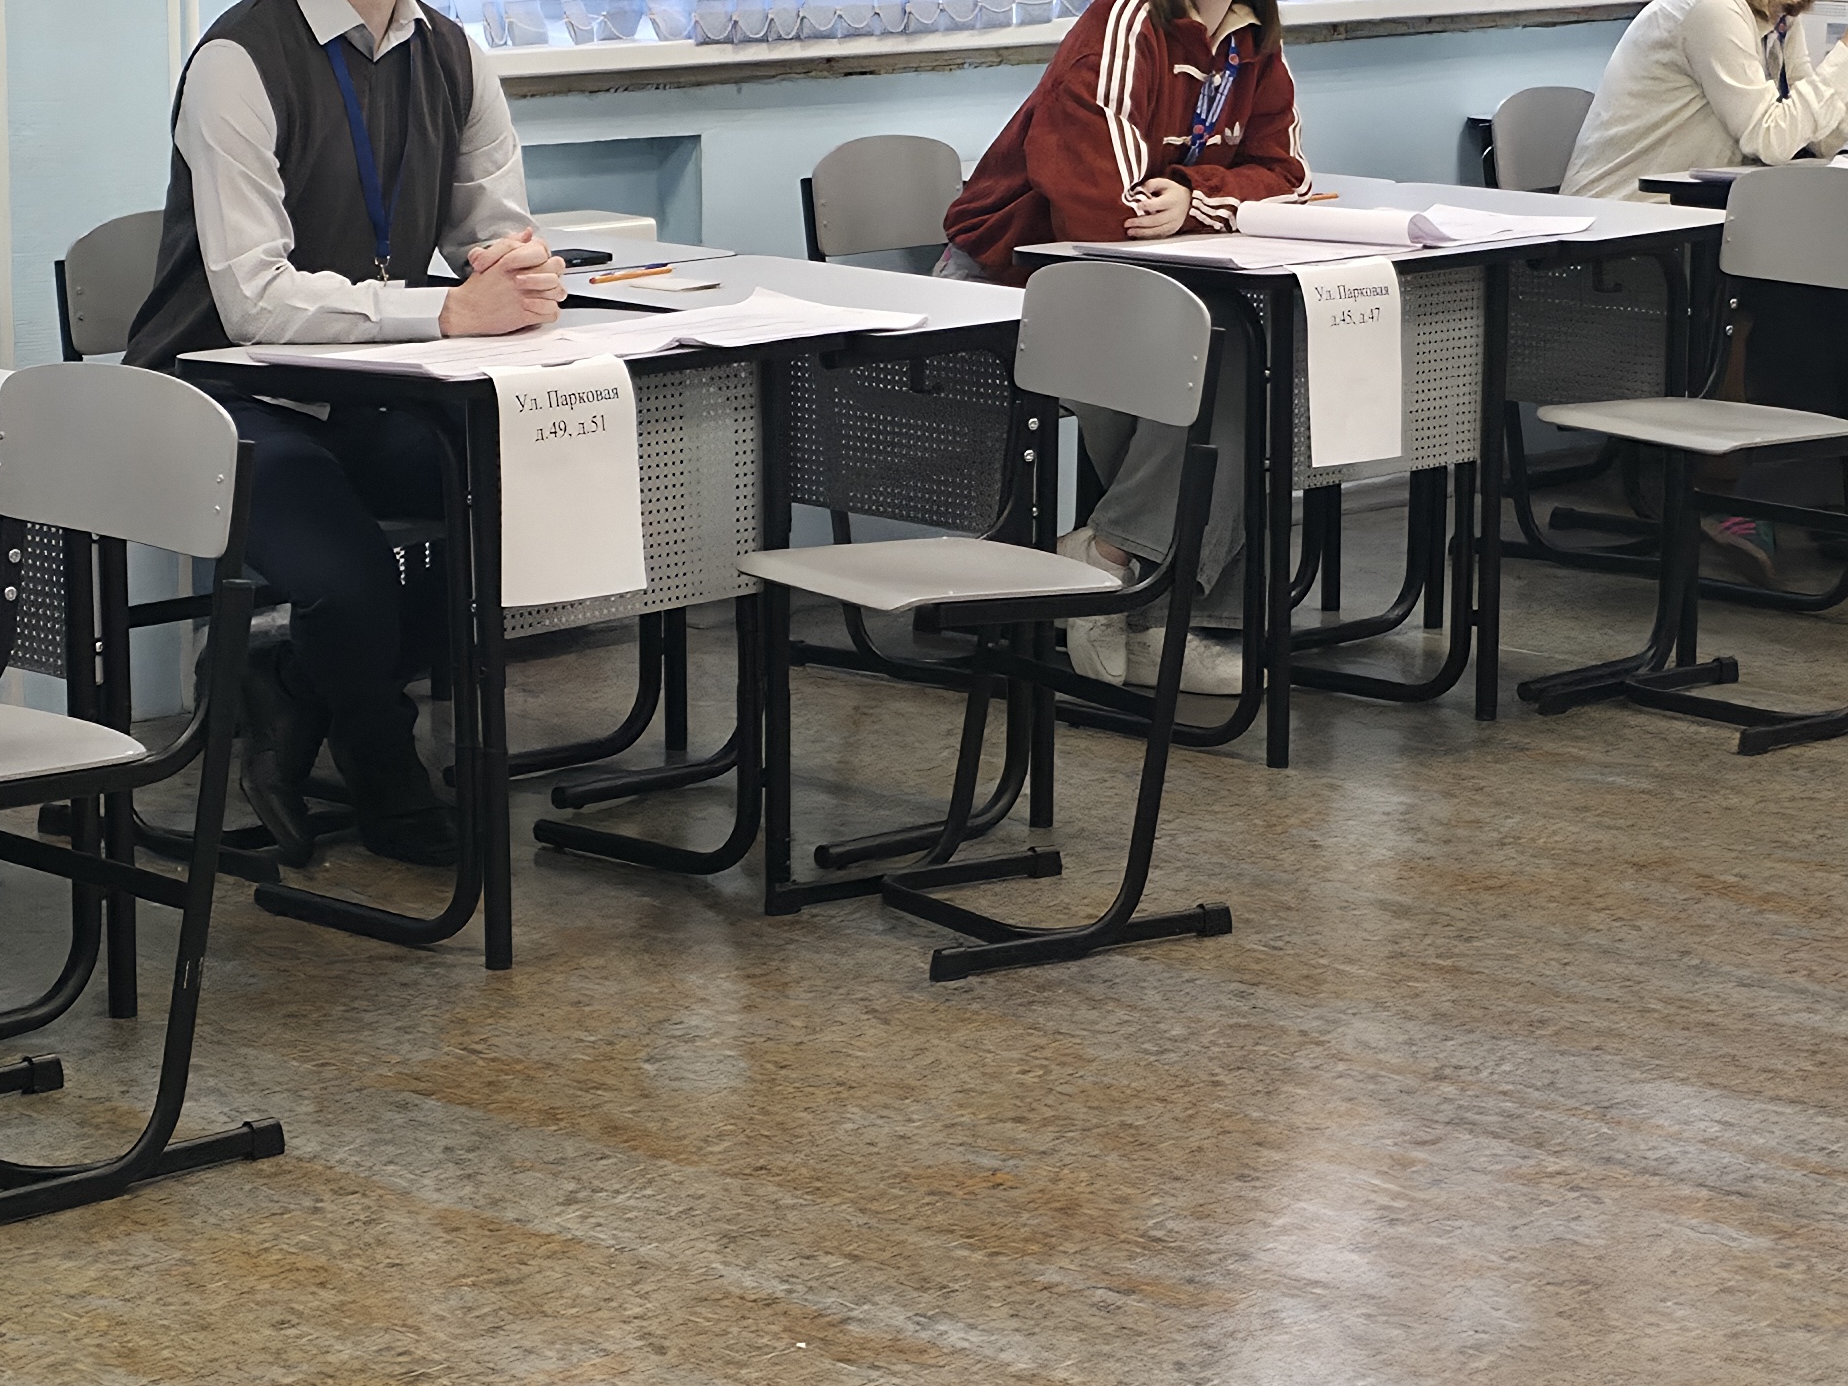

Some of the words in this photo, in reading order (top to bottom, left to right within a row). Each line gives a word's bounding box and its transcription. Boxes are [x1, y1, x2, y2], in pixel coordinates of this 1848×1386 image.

[1314, 286, 1334, 302] Ул.
[1337, 284, 1390, 303] Парковая
[515, 393, 543, 413] Ул.
[547, 386, 620, 411] Парковая
[534, 419, 573, 442] д.49,
[576, 414, 606, 436] д.51
